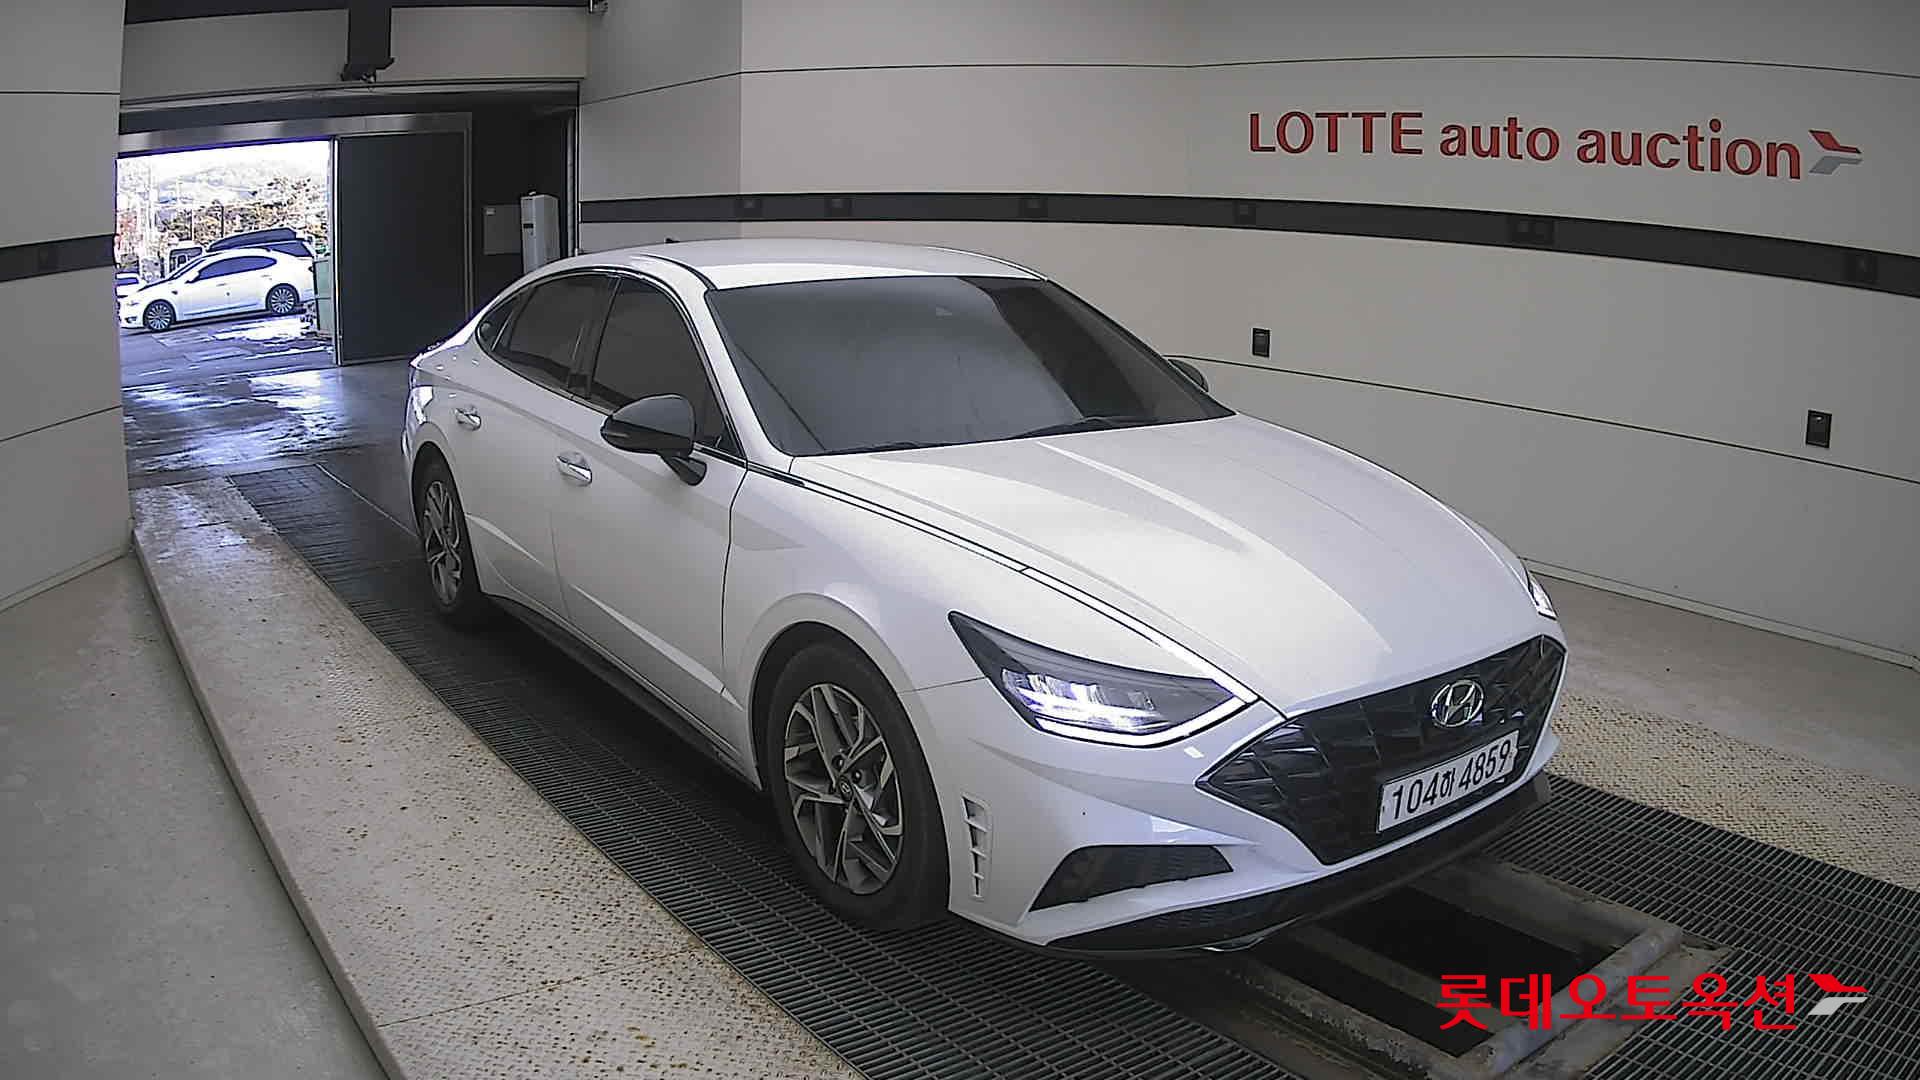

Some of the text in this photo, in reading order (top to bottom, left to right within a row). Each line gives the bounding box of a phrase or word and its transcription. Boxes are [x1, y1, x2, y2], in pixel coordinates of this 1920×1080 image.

[1249, 111, 1802, 180] LOTTE auto auction
[1458, 739, 1512, 791] 4859
